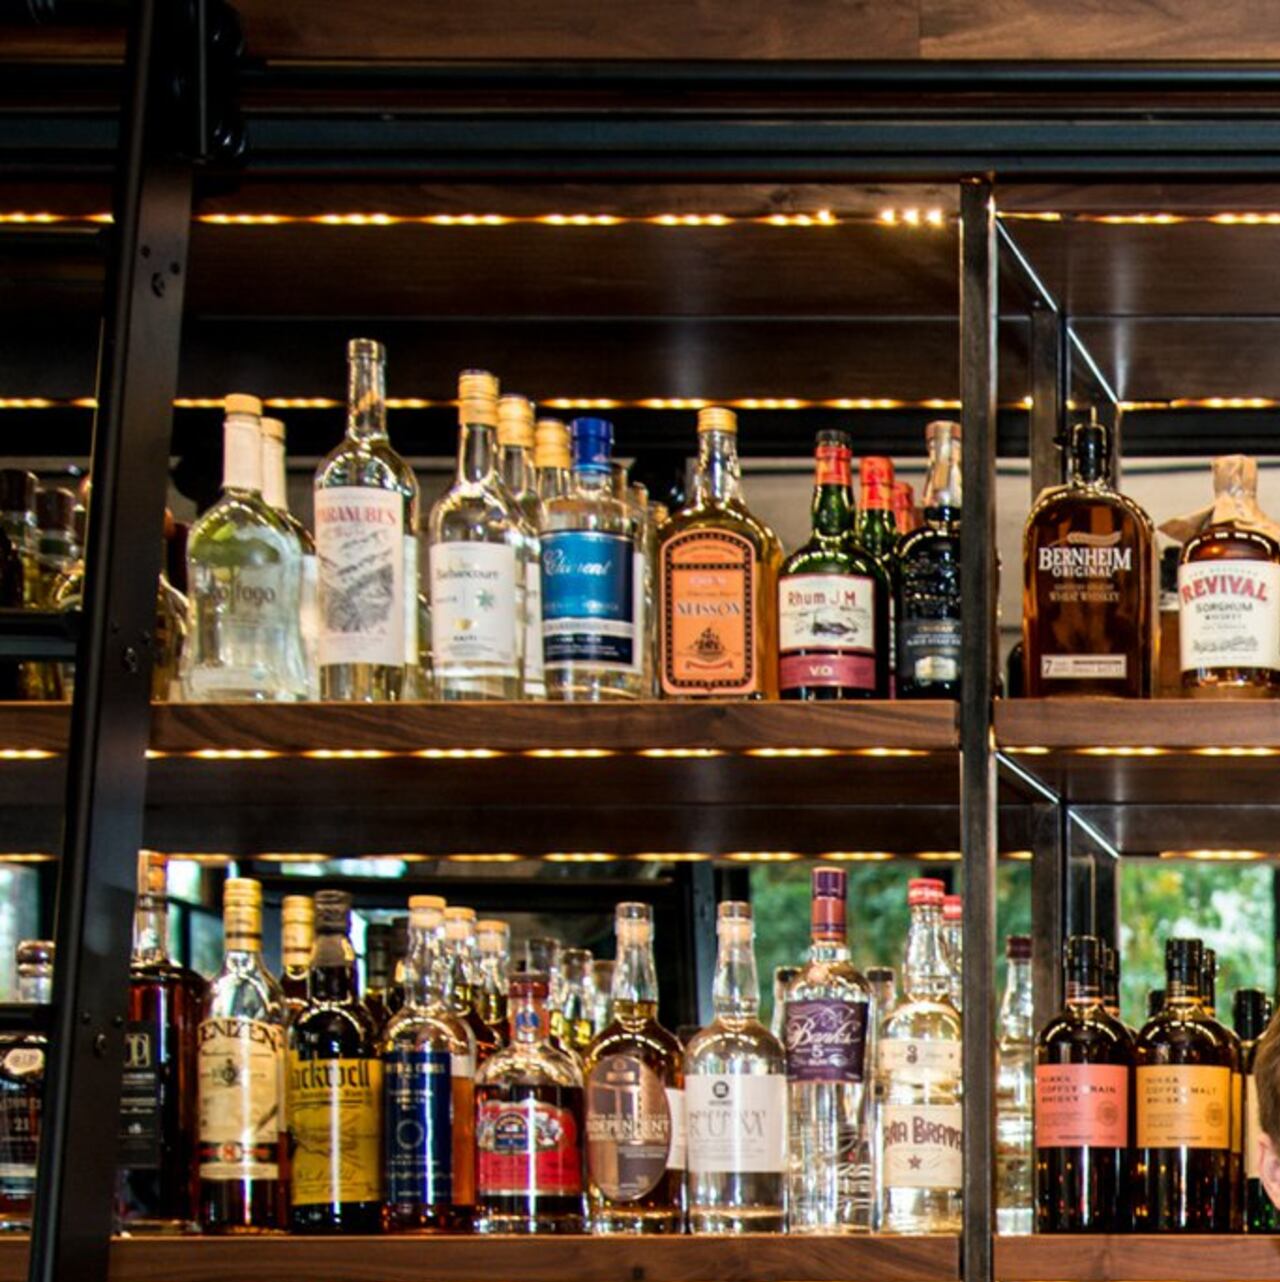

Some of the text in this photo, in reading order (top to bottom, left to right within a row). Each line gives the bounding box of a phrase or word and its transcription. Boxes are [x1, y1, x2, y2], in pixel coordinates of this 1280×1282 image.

[1038, 547, 1132, 571] BERNHEIM
[1052, 566, 1113, 578] ORIGINAL
[788, 591, 826, 606] Rhum
[1181, 574, 1267, 604] REVIVAL
[201, 1018, 277, 1052] ENIZEN
[788, 1020, 860, 1050] Banks
[689, 1109, 767, 1137] RUM
